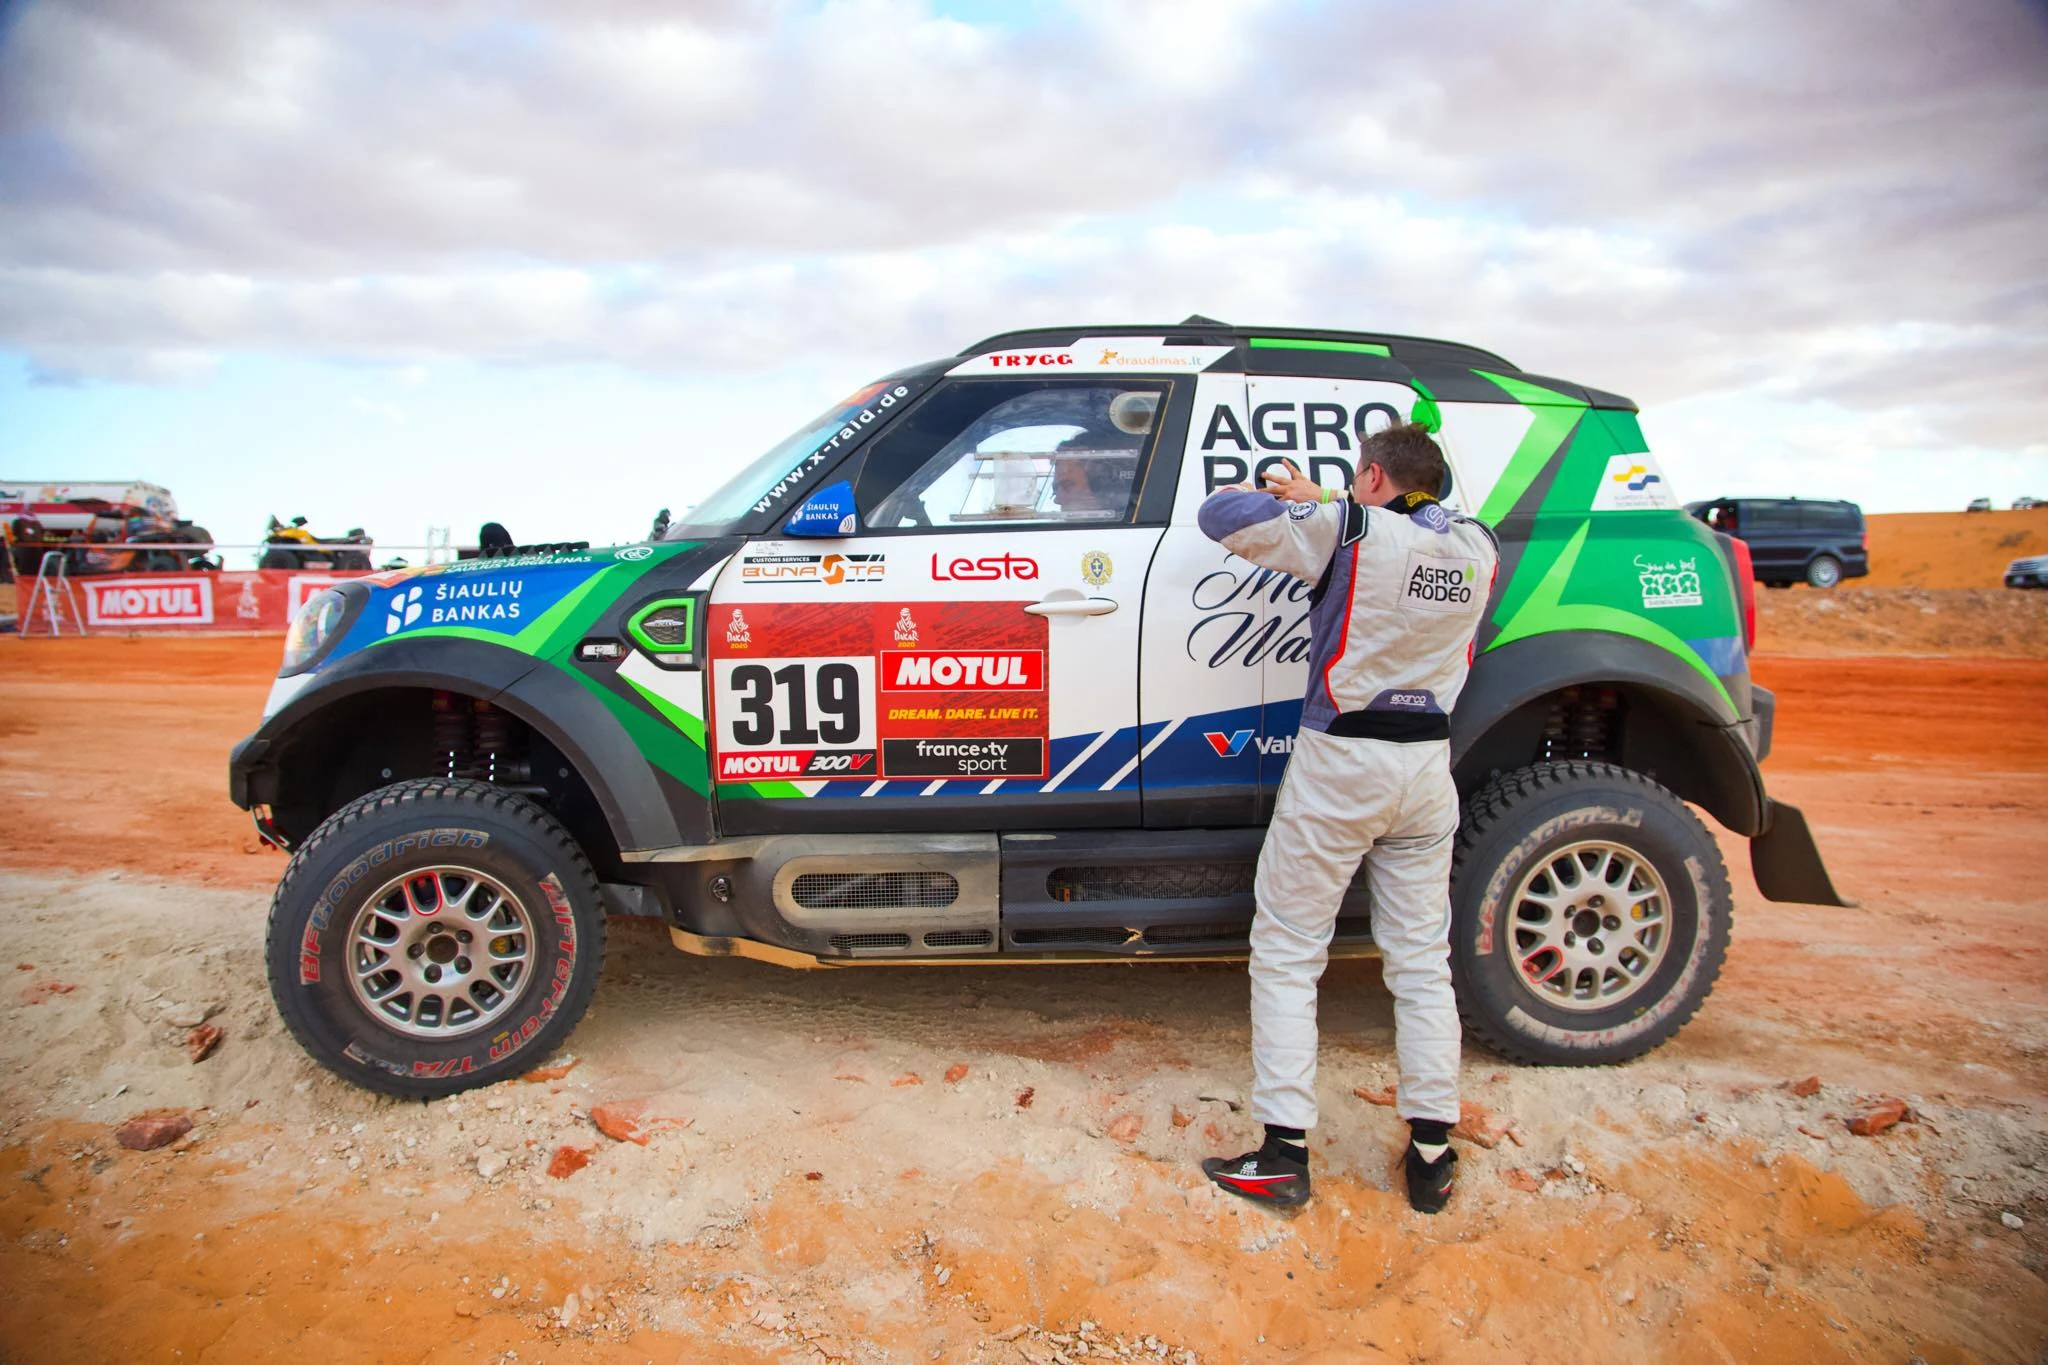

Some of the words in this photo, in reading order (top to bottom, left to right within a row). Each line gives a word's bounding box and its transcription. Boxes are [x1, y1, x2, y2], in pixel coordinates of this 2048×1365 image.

[989, 354, 1073, 366] TRYGG
[1116, 354, 1203, 367] draudimas.lt
[752, 385, 909, 514] www.x-raid.de
[805, 512, 839, 520] BANKAS
[1411, 564, 1464, 586] AGRO
[435, 580, 523, 600] ŠIAULIŲ
[1407, 580, 1471, 603] RODEO
[102, 588, 199, 615] MOTUL
[431, 603, 521, 622] BANKAS
[727, 631, 751, 643] DAKAR
[894, 630, 919, 642] DAKAR
[896, 656, 1028, 686] MOTUL
[730, 662, 861, 747] 319
[888, 708, 942, 720] DREAM.
[945, 708, 986, 720] DARE.
[989, 707, 1020, 719] LIVE
[1022, 707, 1039, 719] IT.
[1255, 735, 1297, 755] Val
[723, 755, 801, 775] MOTUL
[808, 753, 874, 771] 300V
[958, 757, 1008, 775] sport
